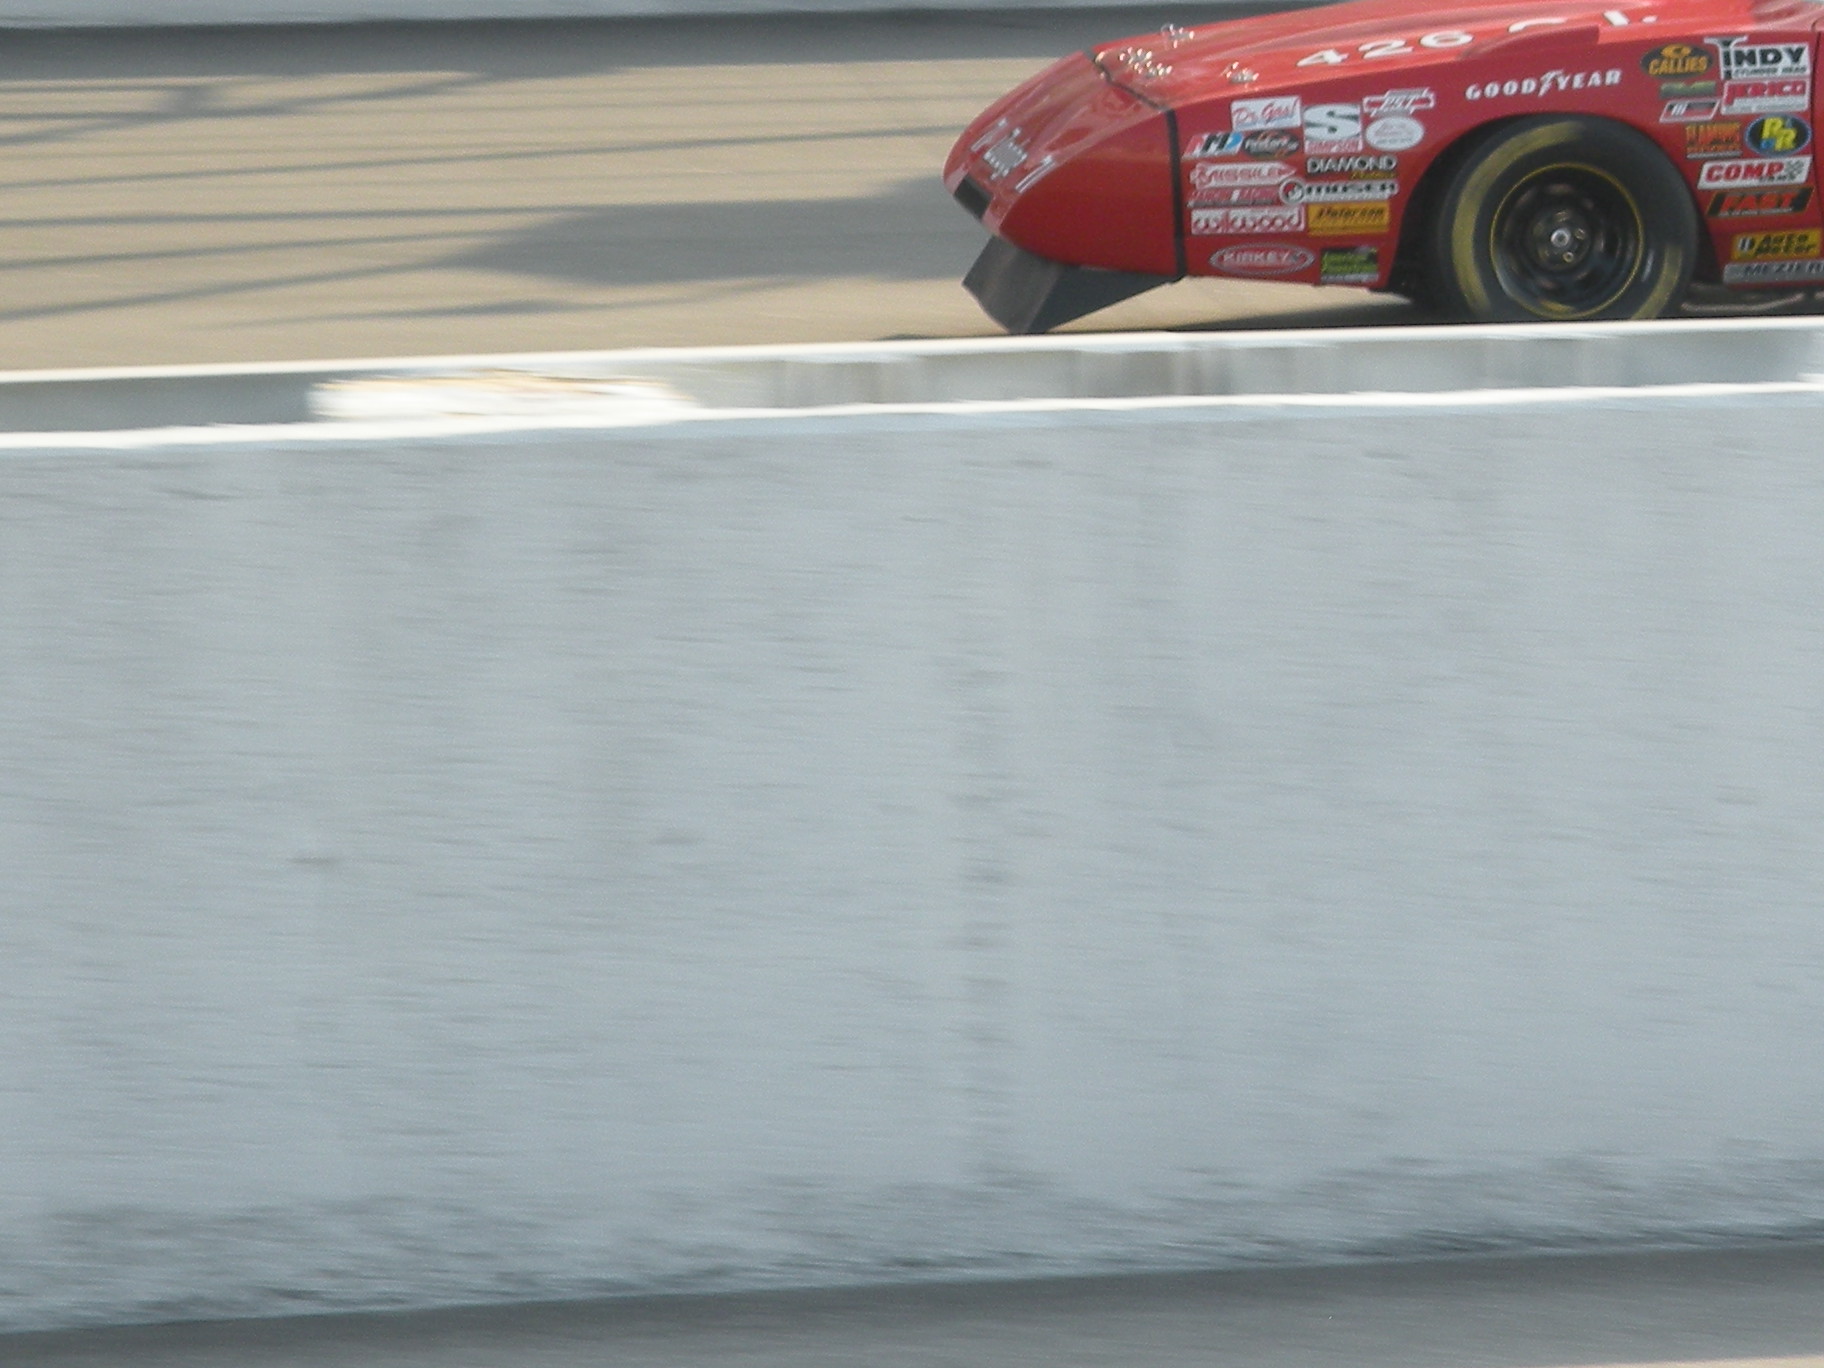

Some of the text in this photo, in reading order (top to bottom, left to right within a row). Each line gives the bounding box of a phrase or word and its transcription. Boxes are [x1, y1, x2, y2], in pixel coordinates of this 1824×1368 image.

[1649, 56, 1709, 76] CALLIES
[1716, 37, 1807, 79] INDY
[1465, 68, 1623, 101] GOODYEAR
[1307, 155, 1397, 174] DIAMOND
[1705, 162, 1785, 182] COMP
